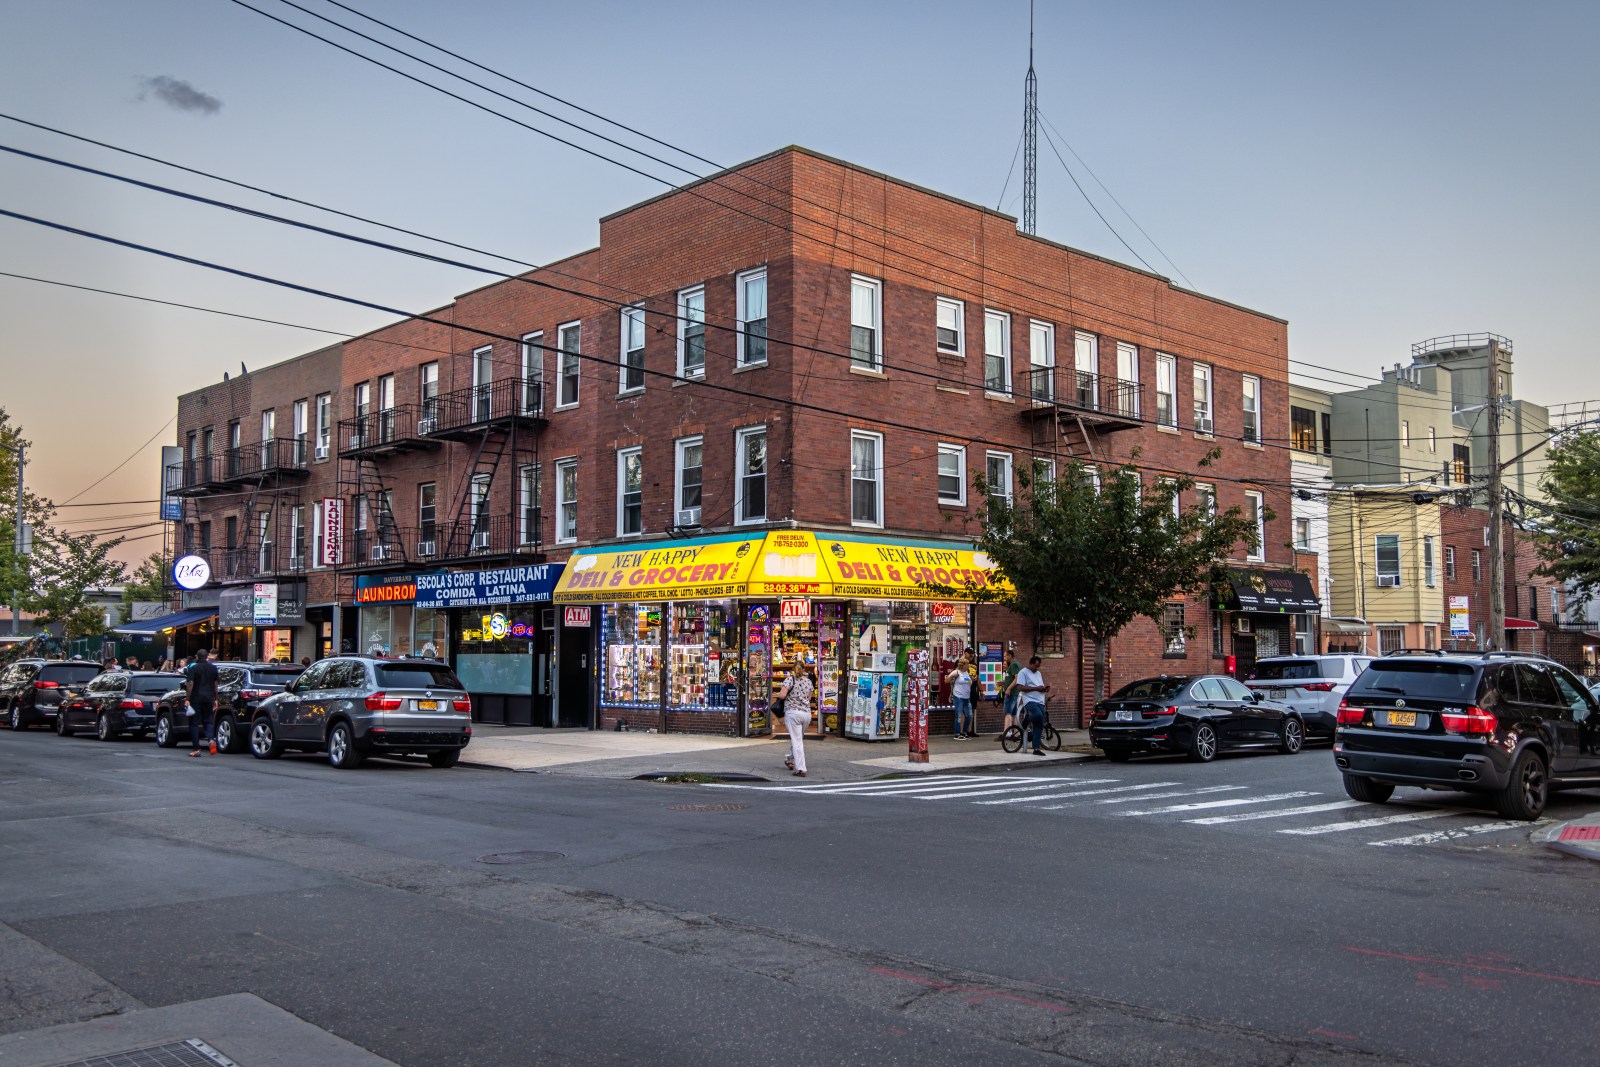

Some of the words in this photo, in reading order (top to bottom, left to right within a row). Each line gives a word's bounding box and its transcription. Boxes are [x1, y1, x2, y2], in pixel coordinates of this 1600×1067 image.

[612, 551, 649, 569] NEW
[649, 546, 705, 566] HAPPY
[877, 546, 910, 563] NEW
[914, 551, 960, 566] HAPPY
[453, 572, 476, 587] CORP.
[479, 565, 548, 586] RESTAURANT
[567, 571, 608, 589] DELI
[609, 569, 624, 586] &
[628, 562, 734, 586] GROCERY
[837, 561, 884, 581] DELI
[886, 564, 902, 582] &
[436, 587, 476, 599] COMIDA
[486, 584, 526, 596] LATINA
[572, 593, 594, 601] SANDWICHES
[602, 592, 611, 600] COLD
[681, 588, 694, 597] LOTTO
[695, 587, 709, 596] PHONE
[710, 586, 723, 595] CARDS
[726, 586, 734, 594] EBT
[737, 585, 746, 593] ATM
[806, 584, 820, 593] Ave
[846, 586, 856, 594] COLD
[857, 587, 881, 595] SANDWICHES
[891, 588, 900, 596] COLD
[901, 588, 922, 597] BEVERAGES
[516, 592, 549, 602] 347-531-0171
[567, 608, 588, 620] ATM
[783, 602, 808, 616] ATM
[934, 602, 956, 616] Coors
[935, 615, 955, 623] LIGHT
[513, 626, 526, 634] OPEN
[1395, 715, 1415, 723] 04569
